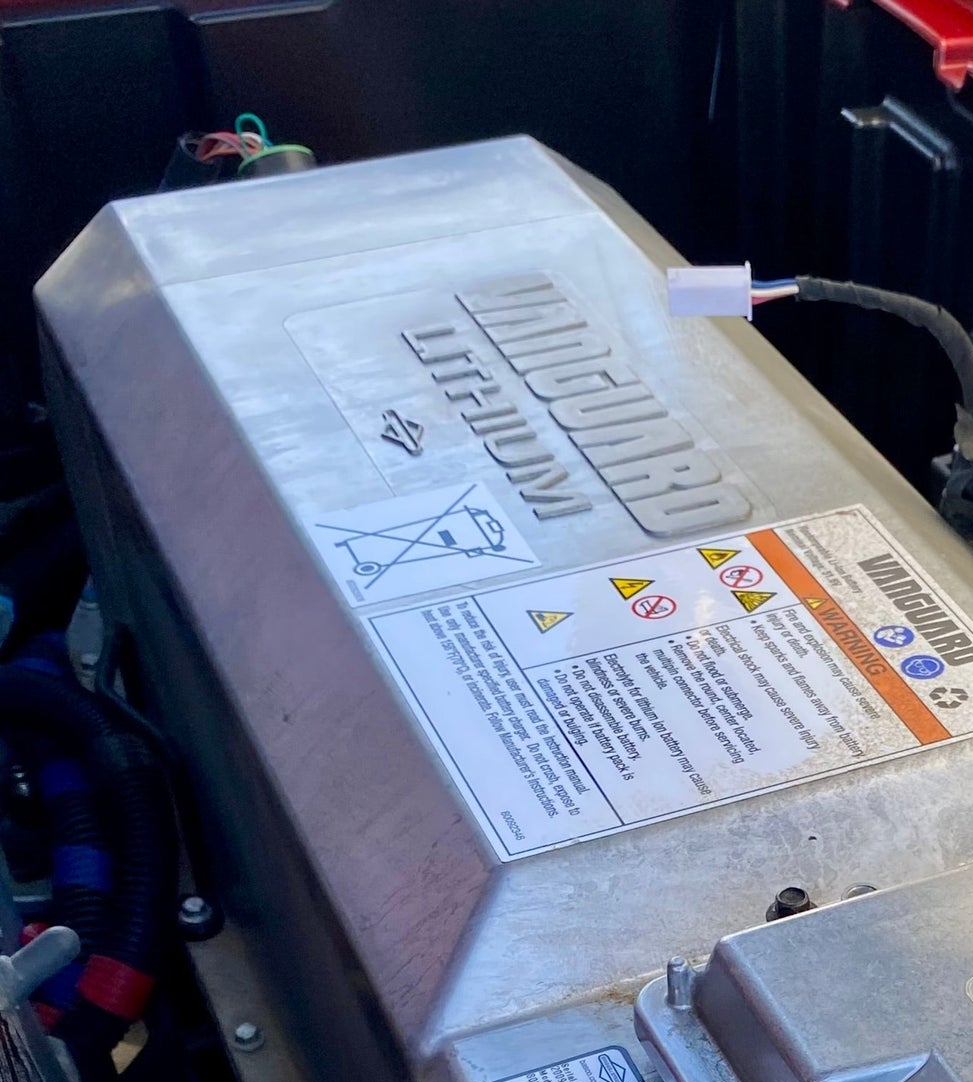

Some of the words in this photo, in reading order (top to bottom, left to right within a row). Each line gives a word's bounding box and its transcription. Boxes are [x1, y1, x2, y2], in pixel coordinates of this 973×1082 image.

[400, 322, 594, 521] LITHIUM
[761, 612, 789, 631] injury
[781, 608, 802, 622] Fire
[472, 628, 490, 640] the
[697, 628, 712, 637] or
[747, 623, 774, 642] Keep
[778, 629, 794, 639] or
[790, 620, 812, 634] and
[478, 638, 498, 652] risk
[685, 639, 703, 651] Do
[703, 635, 730, 657] death.
[714, 624, 748, 654] Electrical
[784, 636, 813, 659] death.
[798, 632, 837, 664] explosion
[815, 607, 889, 677] WARNING
[486, 650, 503, 660] of
[634, 652, 653, 665] the
[669, 643, 699, 671] Remove
[692, 649, 712, 662] not
[736, 652, 763, 673] shock
[761, 640, 791, 664] sparks
[553, 673, 571, 685] Do
[571, 669, 589, 680] Do
[584, 657, 618, 690] blindness
[599, 652, 638, 689] Electrolyte
[642, 663, 672, 690] vehicle.
[688, 669, 709, 683] the
[700, 660, 725, 679] flood
[779, 661, 802, 676] and
[822, 662, 846, 678] may
[474, 667, 505, 696] specified
[503, 677, 522, 692] user
[560, 683, 579, 697] not
[577, 678, 597, 692] not
[713, 677, 729, 687] or
[748, 672, 771, 689] may
[790, 674, 820, 699] flames
[837, 676, 863, 698] cause
[512, 691, 534, 709] must
[533, 676, 568, 710] damaged
[605, 687, 621, 698] or
[626, 686, 645, 698] for
[696, 681, 725, 705] round,
[716, 684, 757, 722] submerge.
[762, 686, 788, 708] cause
[490, 693, 519, 717] battery
[524, 707, 545, 724] read
[555, 708, 572, 719] or
[565, 695, 596, 724] operate
[586, 690, 626, 735] disassemble
[610, 695, 637, 720] severe
[633, 696, 662, 721] lithium
[649, 647, 682, 676] multipin
[670, 674, 706, 709] connector
[696, 707, 724, 732] before
[711, 730, 748, 764] servicing
[713, 703, 741, 727] center
[806, 697, 832, 717] away
[854, 696, 882, 720] severe
[460, 673, 474, 682] or
[484, 710, 509, 733] Follow
[497, 730, 539, 779] Manufacturer's
[505, 714, 535, 741] charger.
[534, 723, 553, 736] the
[586, 721, 602, 729] if
[650, 719, 671, 733] ion
[778, 706, 806, 731] severe
[823, 714, 848, 733] from
[559, 716, 593, 747] bulging.
[627, 718, 655, 742] burns.
[729, 725, 763, 756] located,
[794, 728, 824, 751] injury
[525, 741, 543, 753] Do
[588, 727, 620, 756] battery
[613, 732, 646, 762] battery.
[655, 731, 689, 759] battery
[835, 731, 870, 760] battery.
[531, 751, 550, 765] not
[605, 752, 632, 774] pack
[673, 756, 696, 774] may
[536, 762, 563, 785] crush,
[562, 766, 593, 796] manual.
[620, 771, 639, 781] is
[687, 772, 713, 796] cause
[548, 783, 577, 809] expose
[566, 806, 584, 817] to
[559, 1061, 578, 1082] Serial
